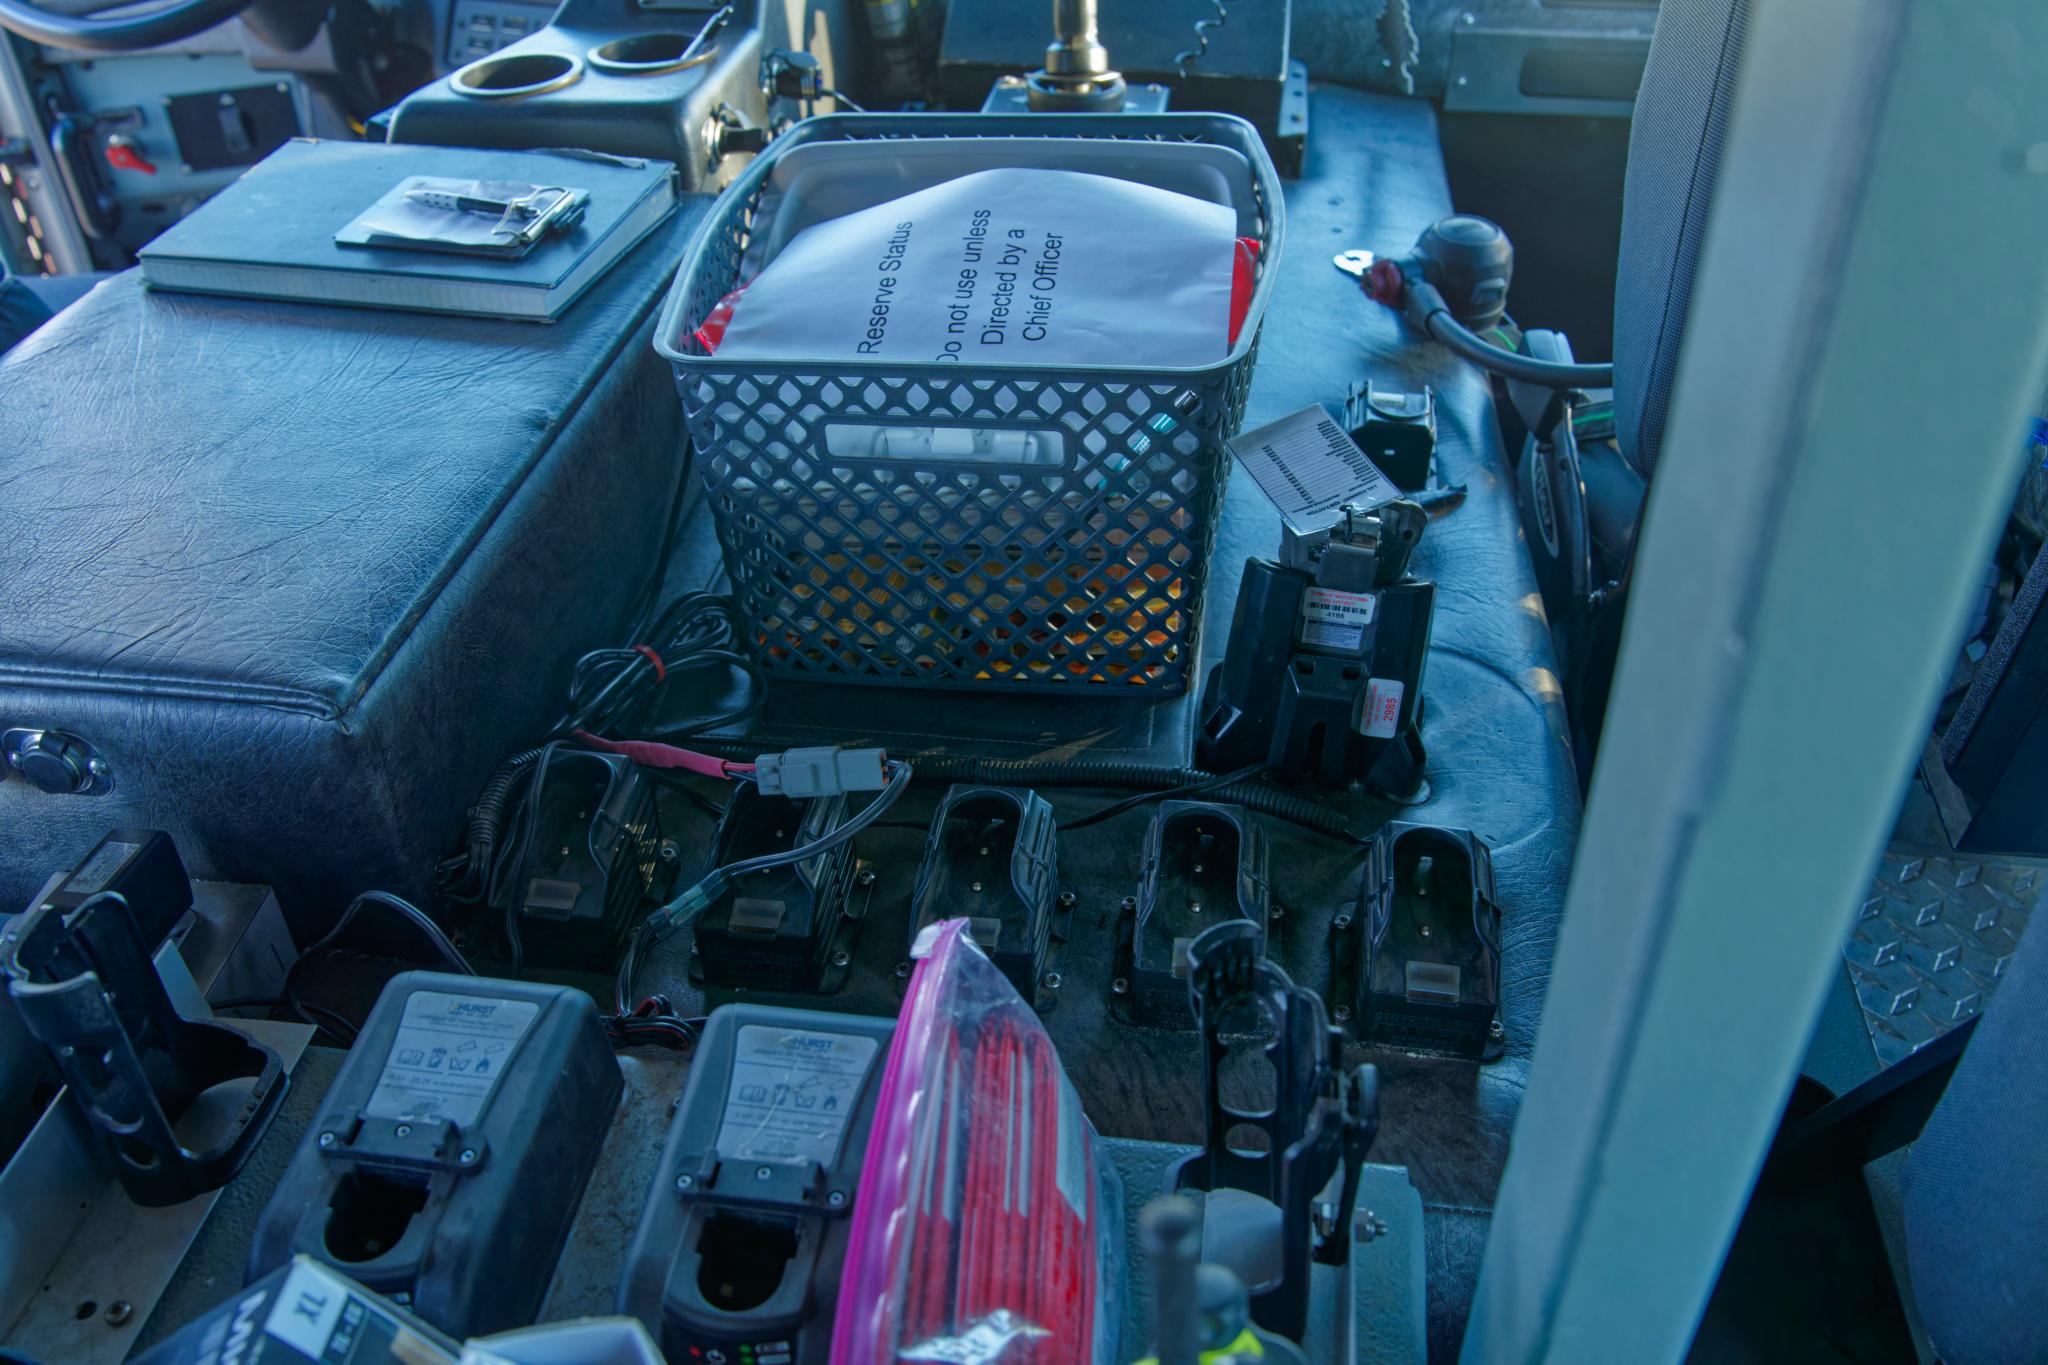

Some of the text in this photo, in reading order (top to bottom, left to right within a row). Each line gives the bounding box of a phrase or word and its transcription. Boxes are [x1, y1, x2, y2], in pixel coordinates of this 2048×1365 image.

[963, 209, 991, 263] unless
[857, 221, 913, 354] Reserve Status
[955, 268, 978, 299] use
[980, 228, 1027, 345] Directed by a
[1022, 232, 1063, 341] Chief Officer
[947, 303, 970, 334] not
[458, 1003, 497, 1014] HURST
[294, 1292, 327, 1327] XL
